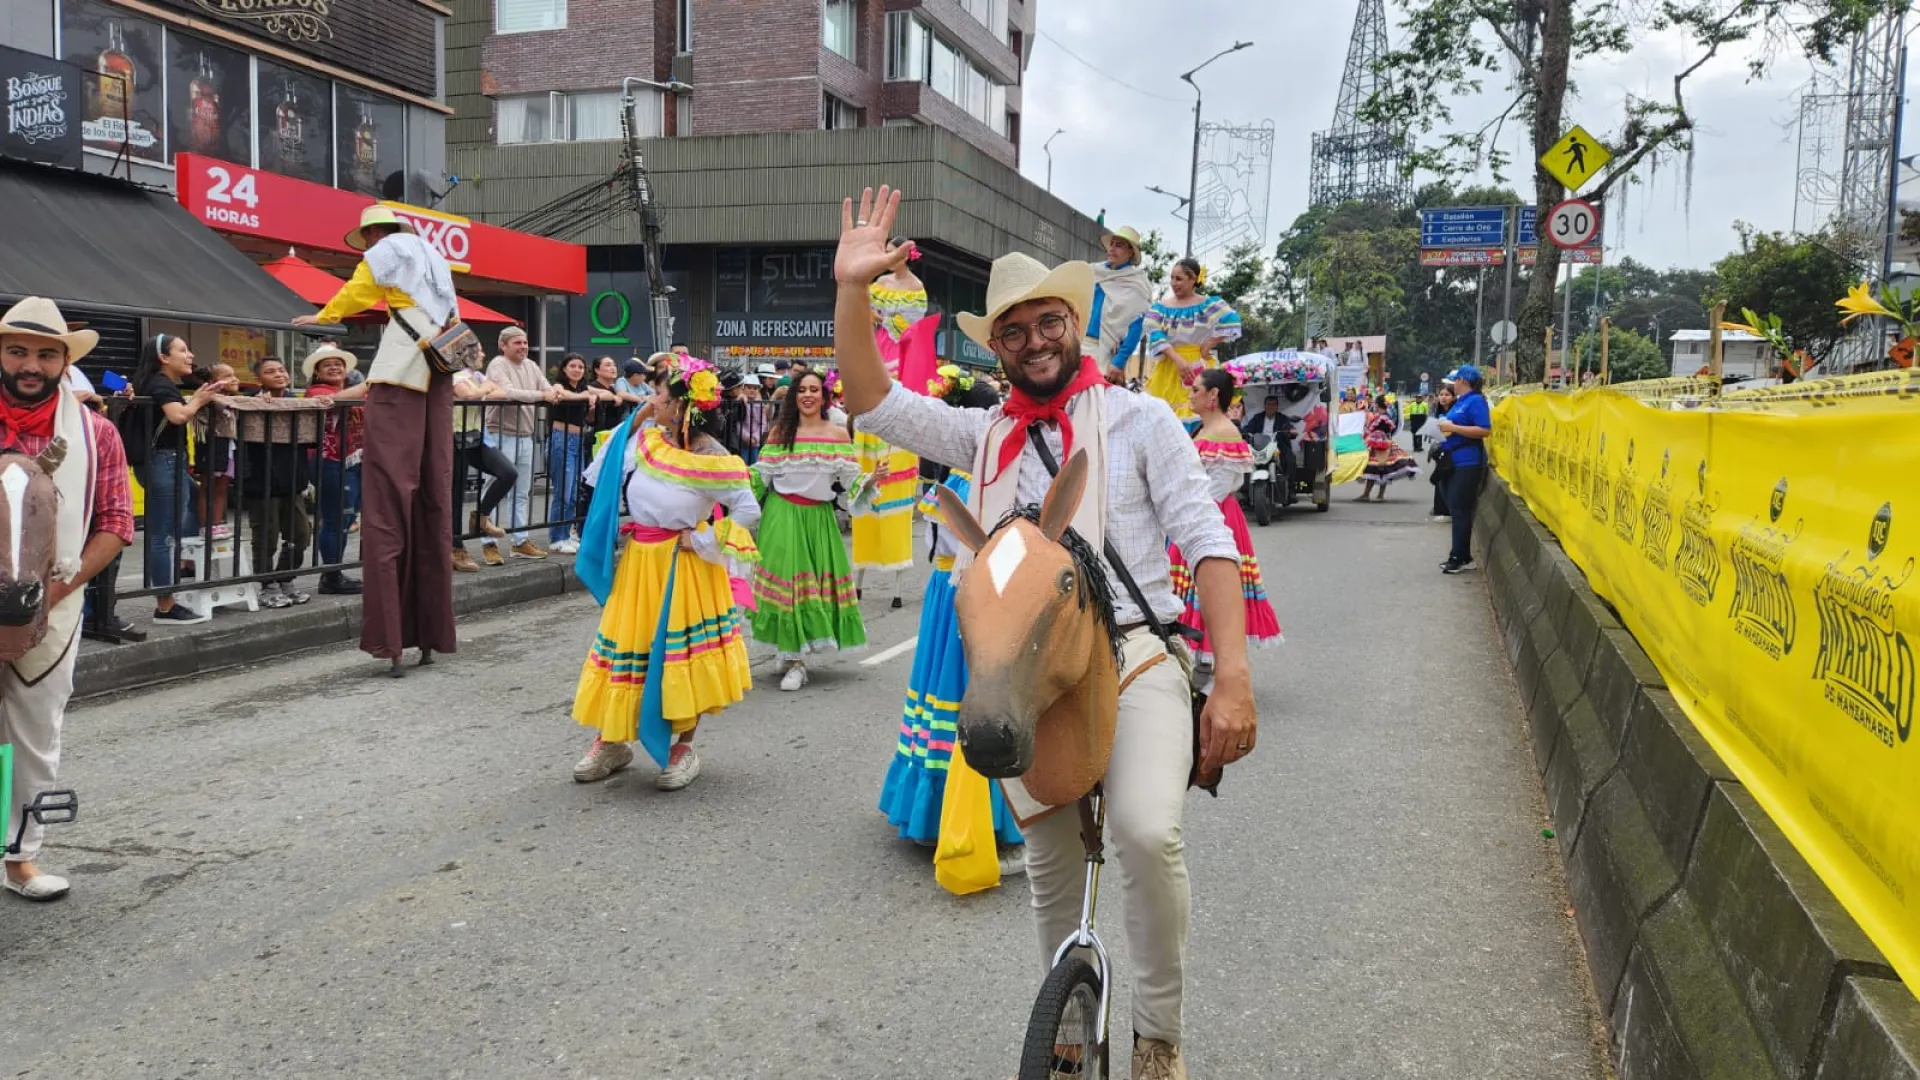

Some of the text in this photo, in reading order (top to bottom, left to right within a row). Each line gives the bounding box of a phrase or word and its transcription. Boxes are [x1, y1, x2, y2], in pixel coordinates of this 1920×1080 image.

[7, 76, 62, 101] BOSQUE
[8, 99, 65, 133] INDIAS
[103, 120, 128, 130] El Ro
[94, 127, 106, 136] los
[206, 166, 259, 209] 24
[205, 205, 259, 228] HORAS
[1476, 223, 1492, 231] Oro
[1556, 212, 1588, 236] 30
[394, 214, 470, 261] XXO
[716, 320, 834, 337] ZONA REFRESCANTE
[1825, 683, 1835, 703] DE
